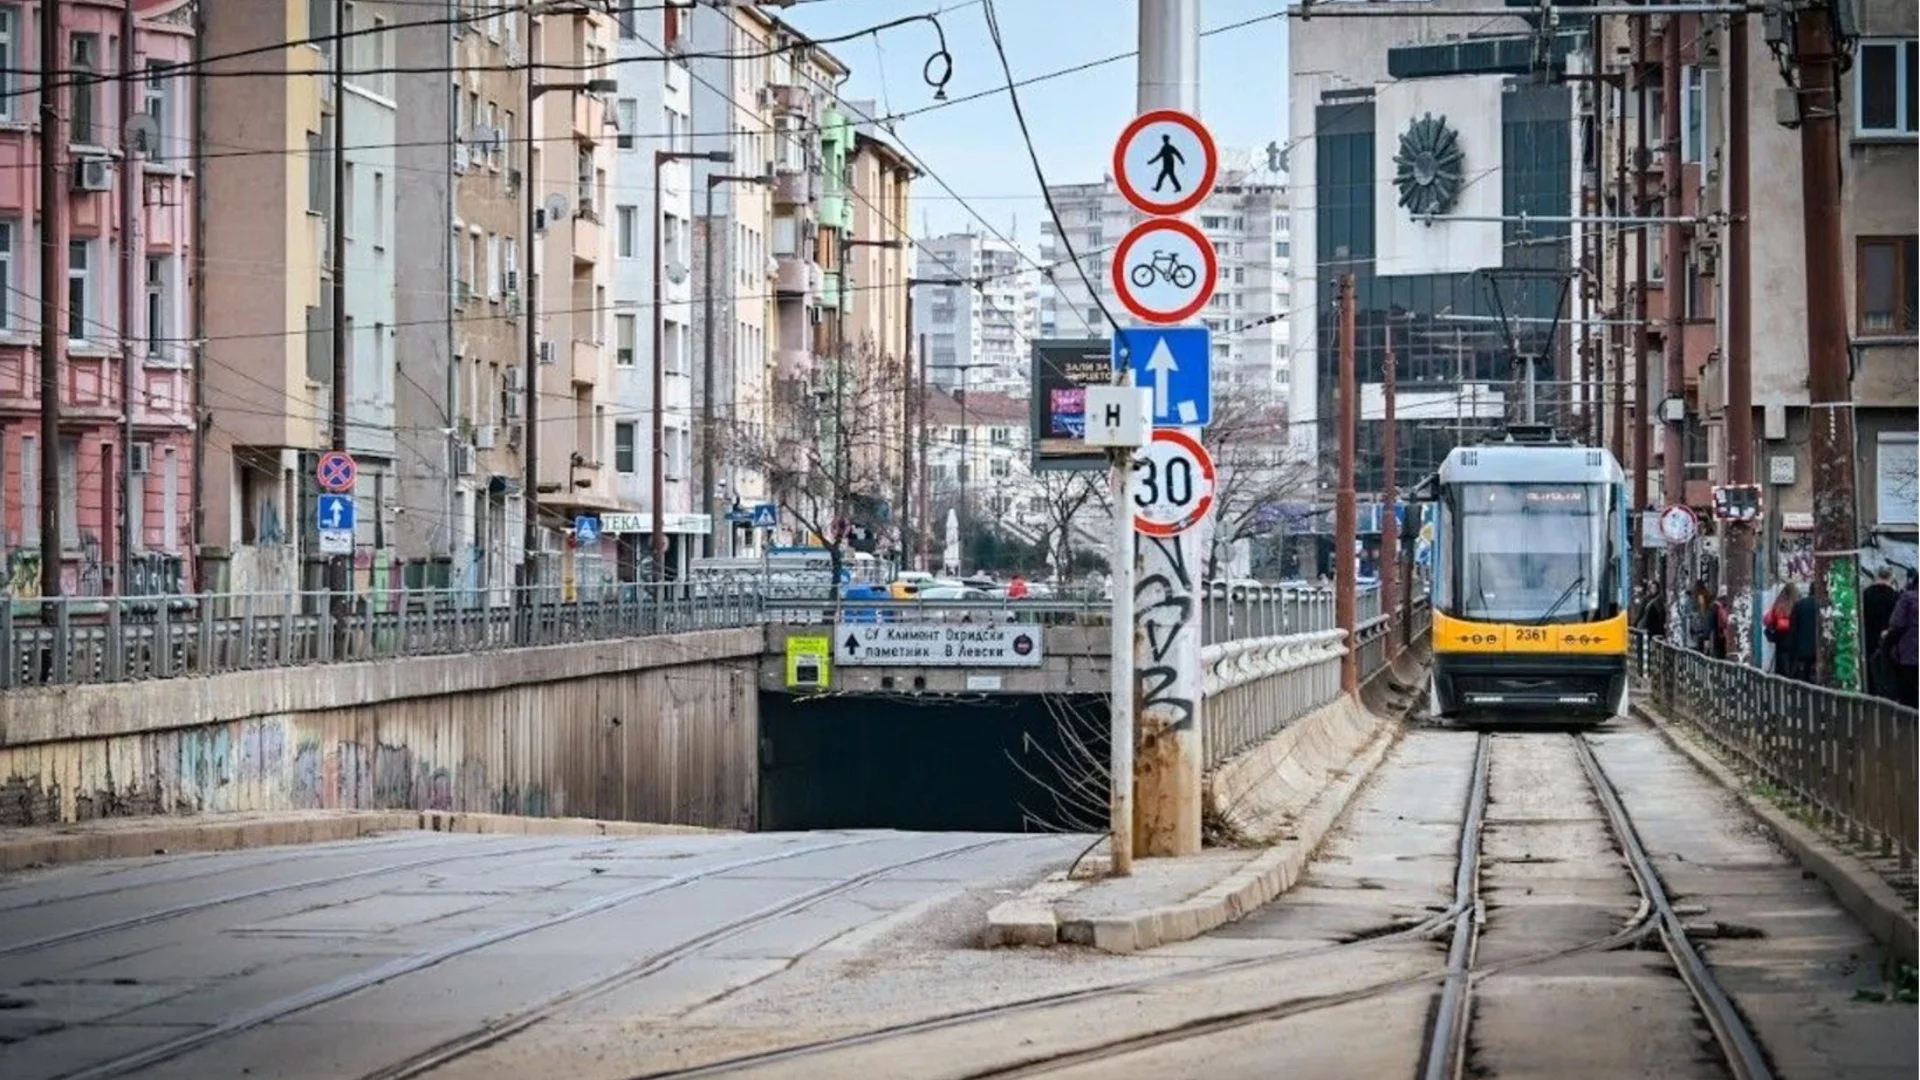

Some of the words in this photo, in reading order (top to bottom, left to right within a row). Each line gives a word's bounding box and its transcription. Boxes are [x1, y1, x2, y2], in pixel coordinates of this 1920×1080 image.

[1133, 456, 1192, 507] 30
[605, 515, 641, 531] ТЕКА
[865, 627, 880, 641] СУ
[945, 627, 1004, 642] Охридски
[1516, 628, 1547, 642] 2361
[865, 646, 930, 658] паметник
